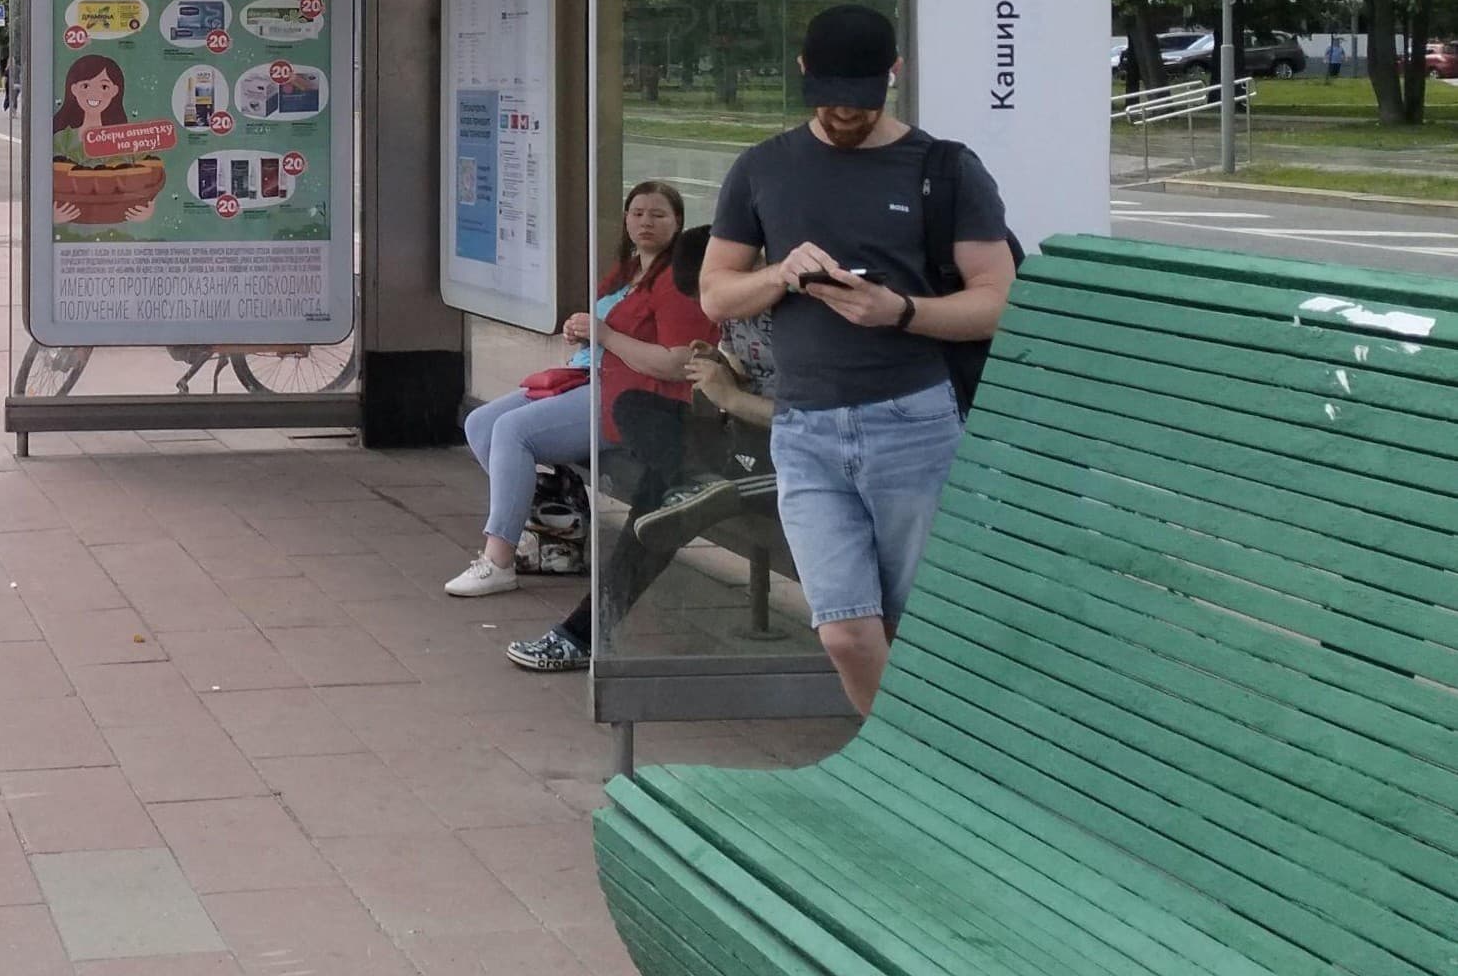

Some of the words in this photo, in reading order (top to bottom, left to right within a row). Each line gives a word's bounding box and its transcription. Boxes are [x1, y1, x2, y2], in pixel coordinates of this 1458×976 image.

[86, 129, 125, 143] Собери
[117, 141, 130, 150] на
[132, 134, 161, 152] дачу!
[60, 276, 115, 297] ИМЕЮТСЯ
[244, 274, 322, 296] НЕОБХОДИМО
[60, 300, 130, 321] ПОЛУЧЕНИЕ
[137, 299, 231, 321] КОНСУЛЬТАЦИИ
[238, 297, 321, 320] СПЕЦИАЛИСТА
